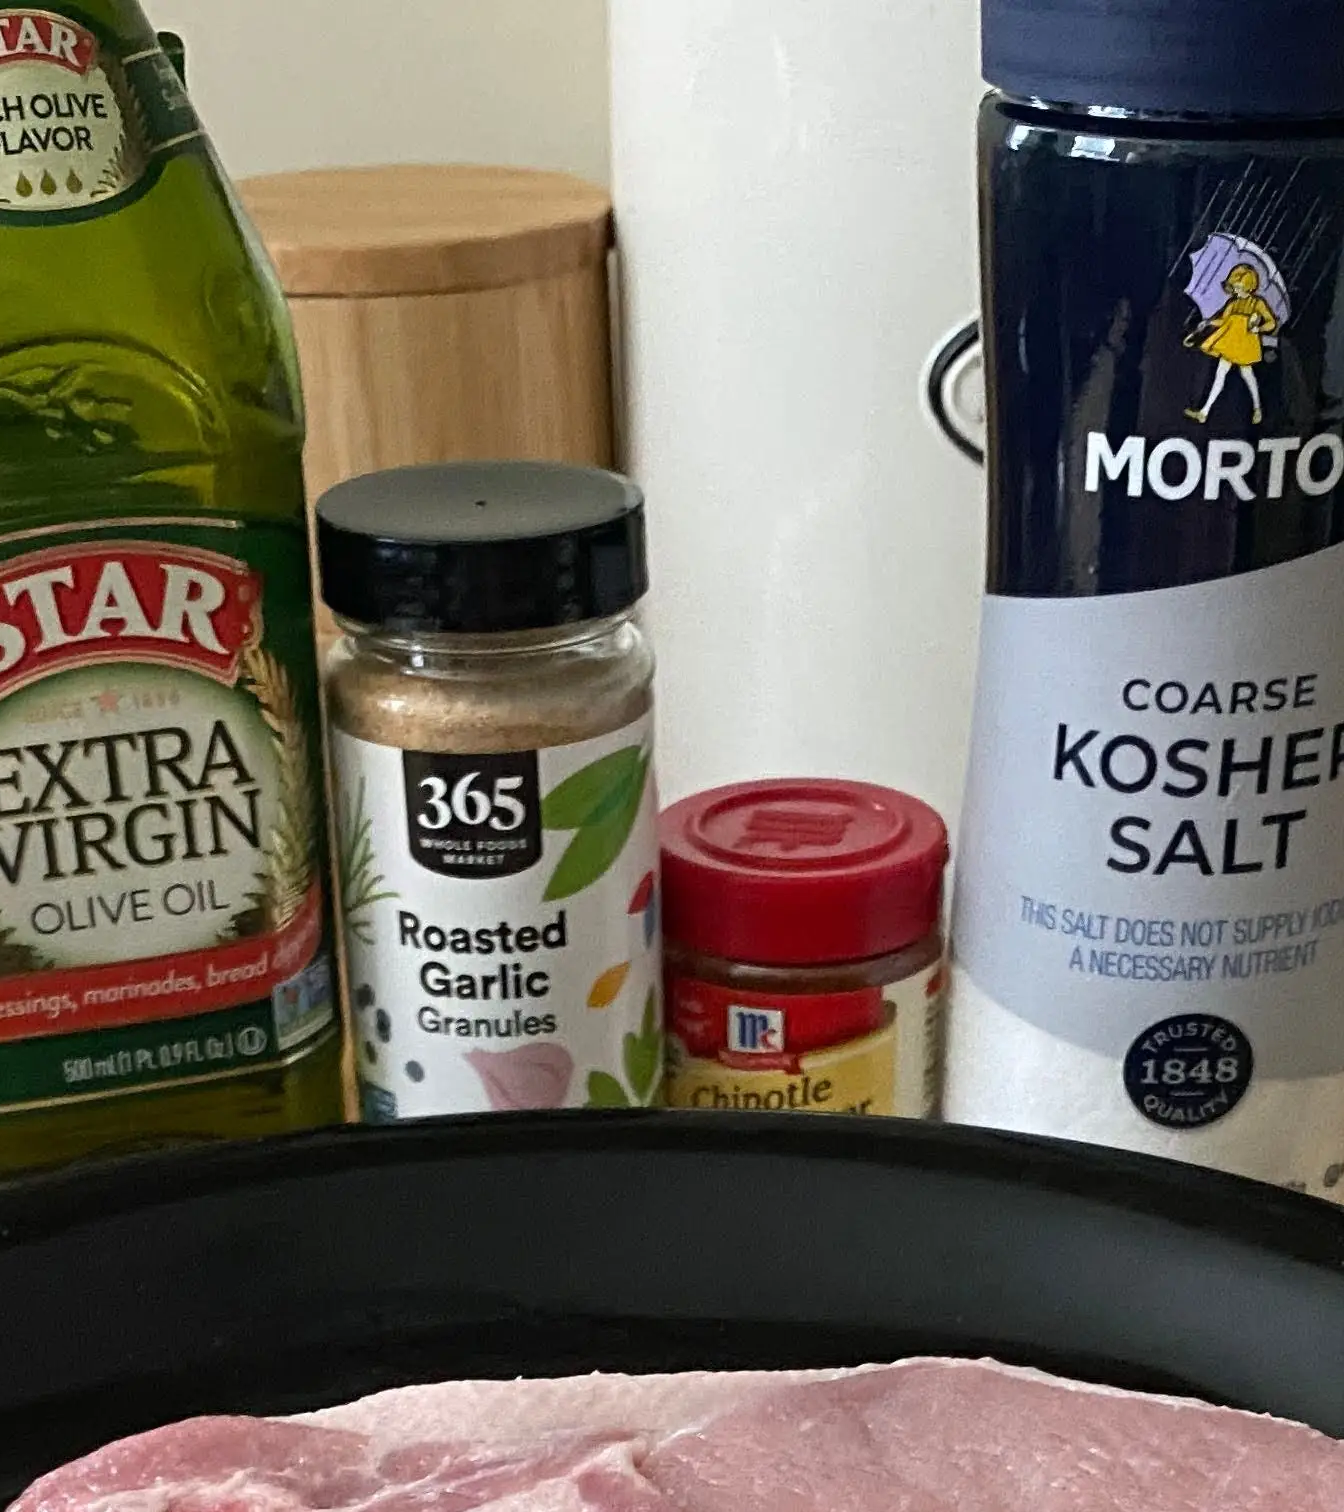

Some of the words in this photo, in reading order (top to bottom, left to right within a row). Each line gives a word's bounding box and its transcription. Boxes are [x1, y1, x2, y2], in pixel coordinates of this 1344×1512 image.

[30, 93, 108, 120] OLIVE
[1122, 674, 1318, 714] COARSE
[417, 771, 526, 831] 365
[442, 854, 505, 865] MARKET
[1106, 809, 1307, 876] SALT
[30, 888, 154, 934] OLIVE
[162, 879, 230, 915] OIL
[1020, 895, 1057, 930] THIS
[1061, 909, 1109, 940] SALT
[1115, 917, 1174, 947] DOES
[1181, 920, 1228, 947] NOT
[1233, 910, 1306, 944] SUPPLY
[399, 910, 567, 954] Roasted
[84, 969, 201, 1005] marinades,
[206, 951, 268, 988] bread
[420, 961, 549, 1000] Garlic
[1069, 946, 1084, 973] A
[1089, 949, 1216, 982] NECESSARY
[1222, 940, 1318, 978] NUTRIENT
[417, 1006, 557, 1038] Granules
[1141, 1022, 1236, 1053] TRUSTED
[1140, 1057, 1237, 1084] 1848
[691, 1074, 833, 1111] Chipotle
[1144, 1086, 1227, 1121] QUALITY
